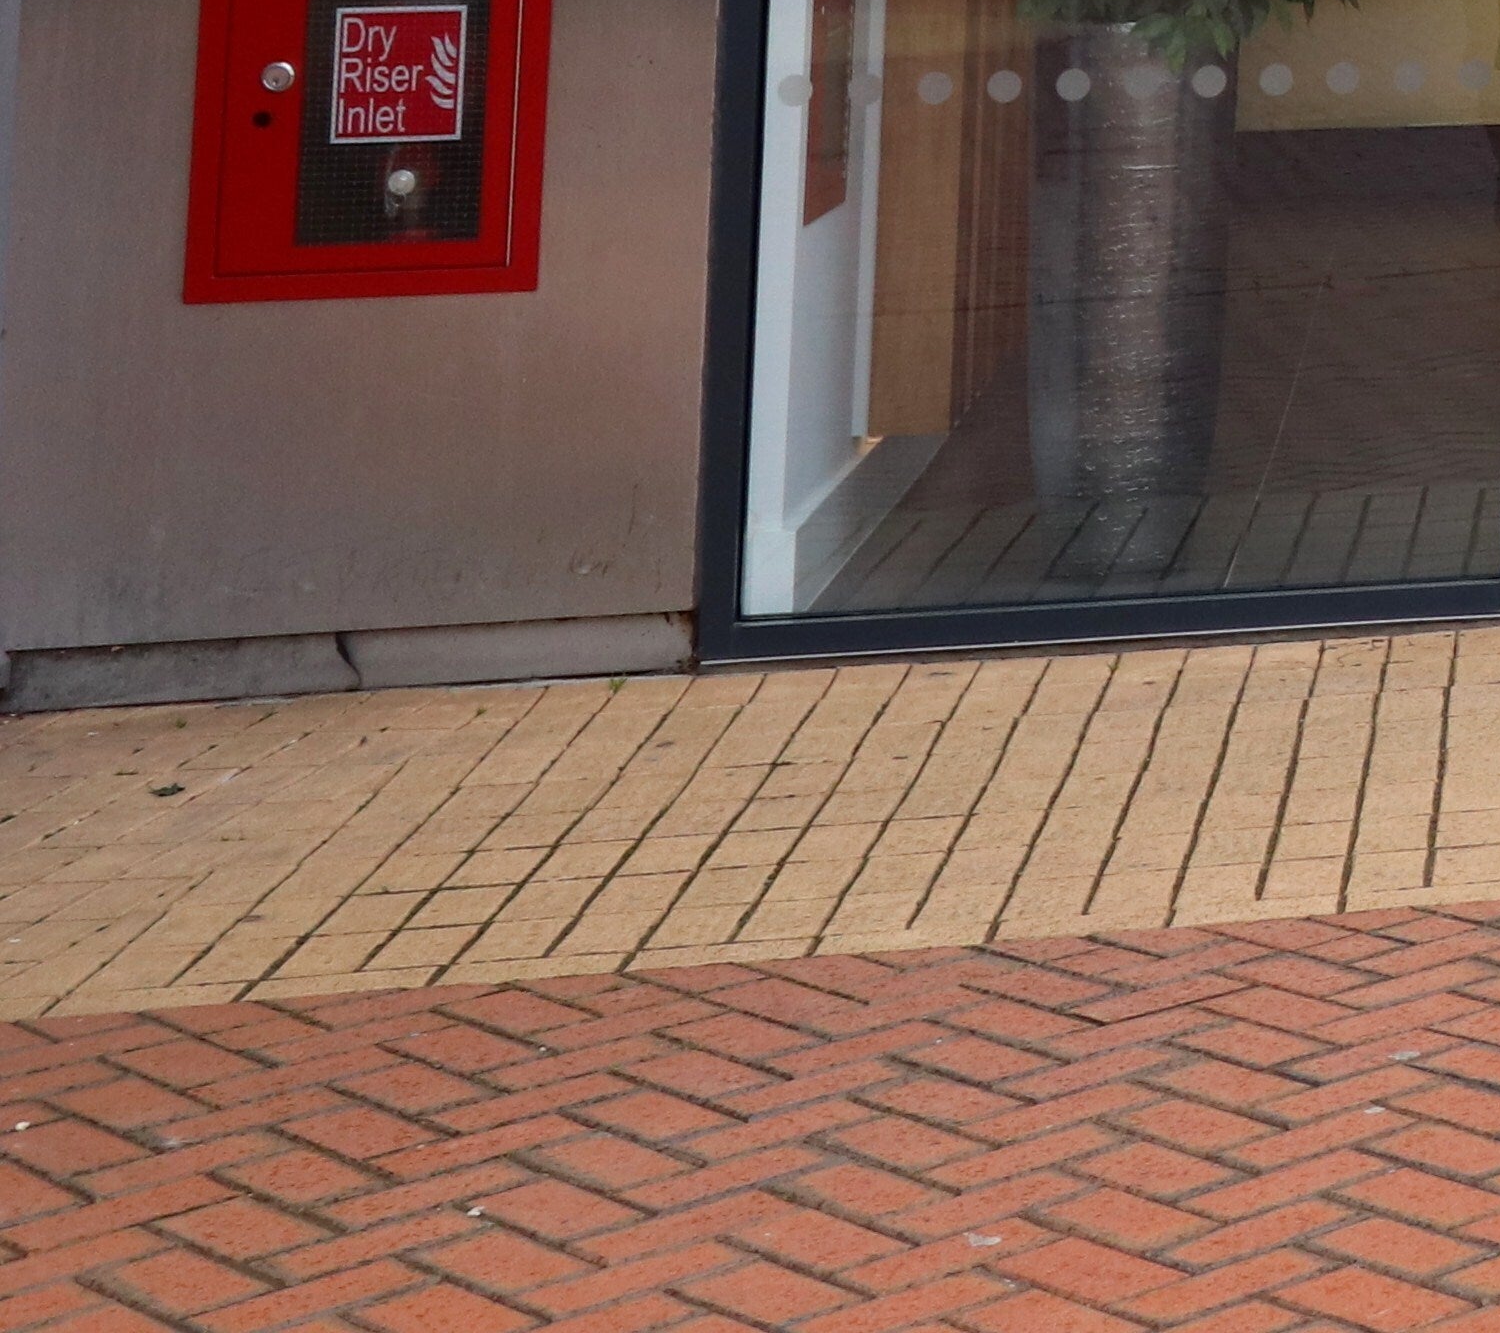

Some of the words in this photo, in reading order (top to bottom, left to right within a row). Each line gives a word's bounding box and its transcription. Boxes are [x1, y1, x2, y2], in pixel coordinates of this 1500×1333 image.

[341, 16, 398, 63] Dry
[339, 56, 425, 94] Riser
[336, 96, 407, 135] Inlet
